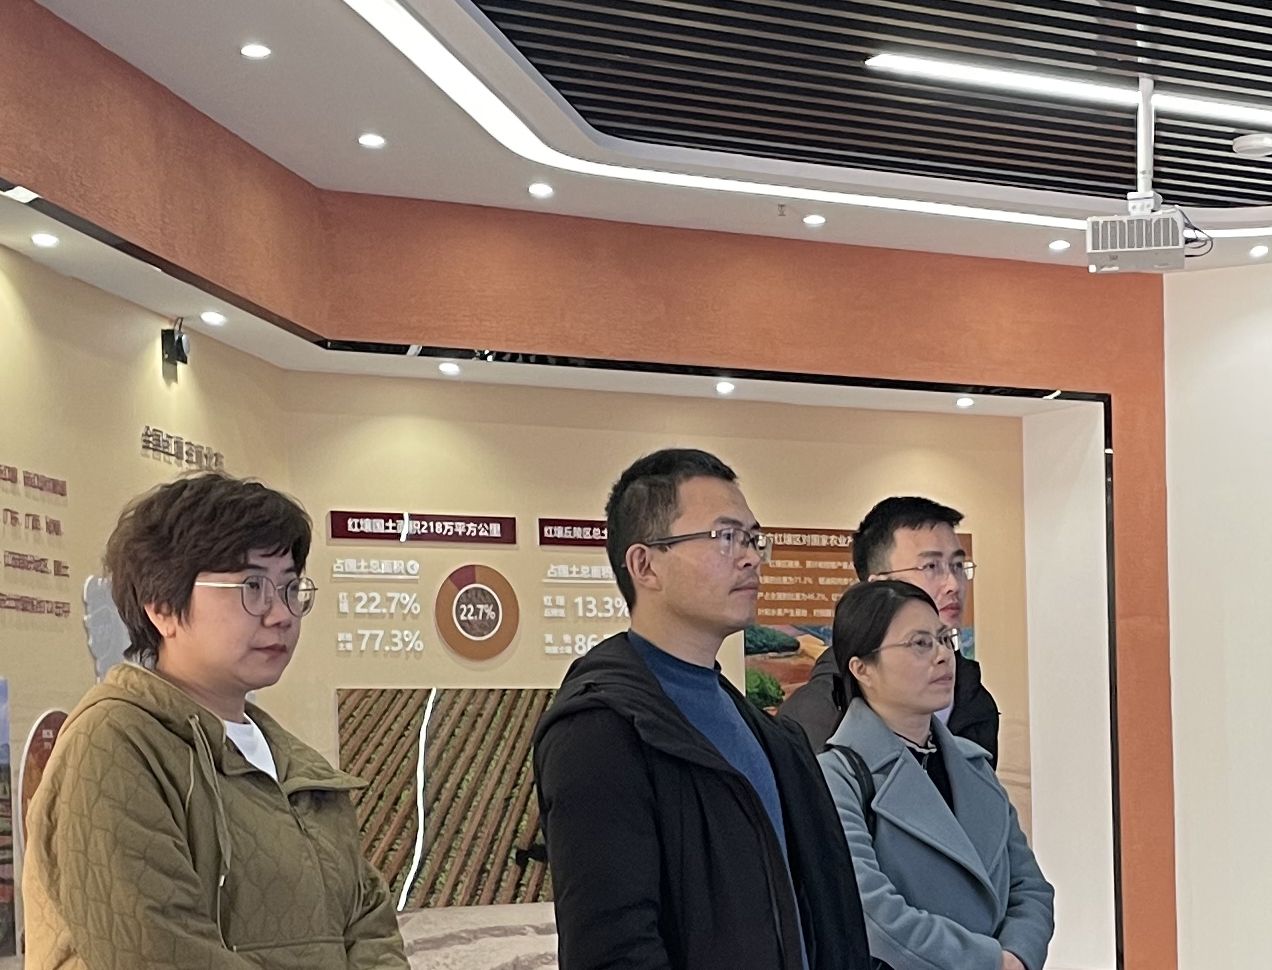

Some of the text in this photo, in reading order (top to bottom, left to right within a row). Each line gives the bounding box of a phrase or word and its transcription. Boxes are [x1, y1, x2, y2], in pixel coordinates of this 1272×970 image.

[355, 592, 421, 614] 22.7%
[459, 604, 496, 621] 22.7%
[574, 596, 631, 618] 13.3%
[357, 629, 424, 652] 77.3%
